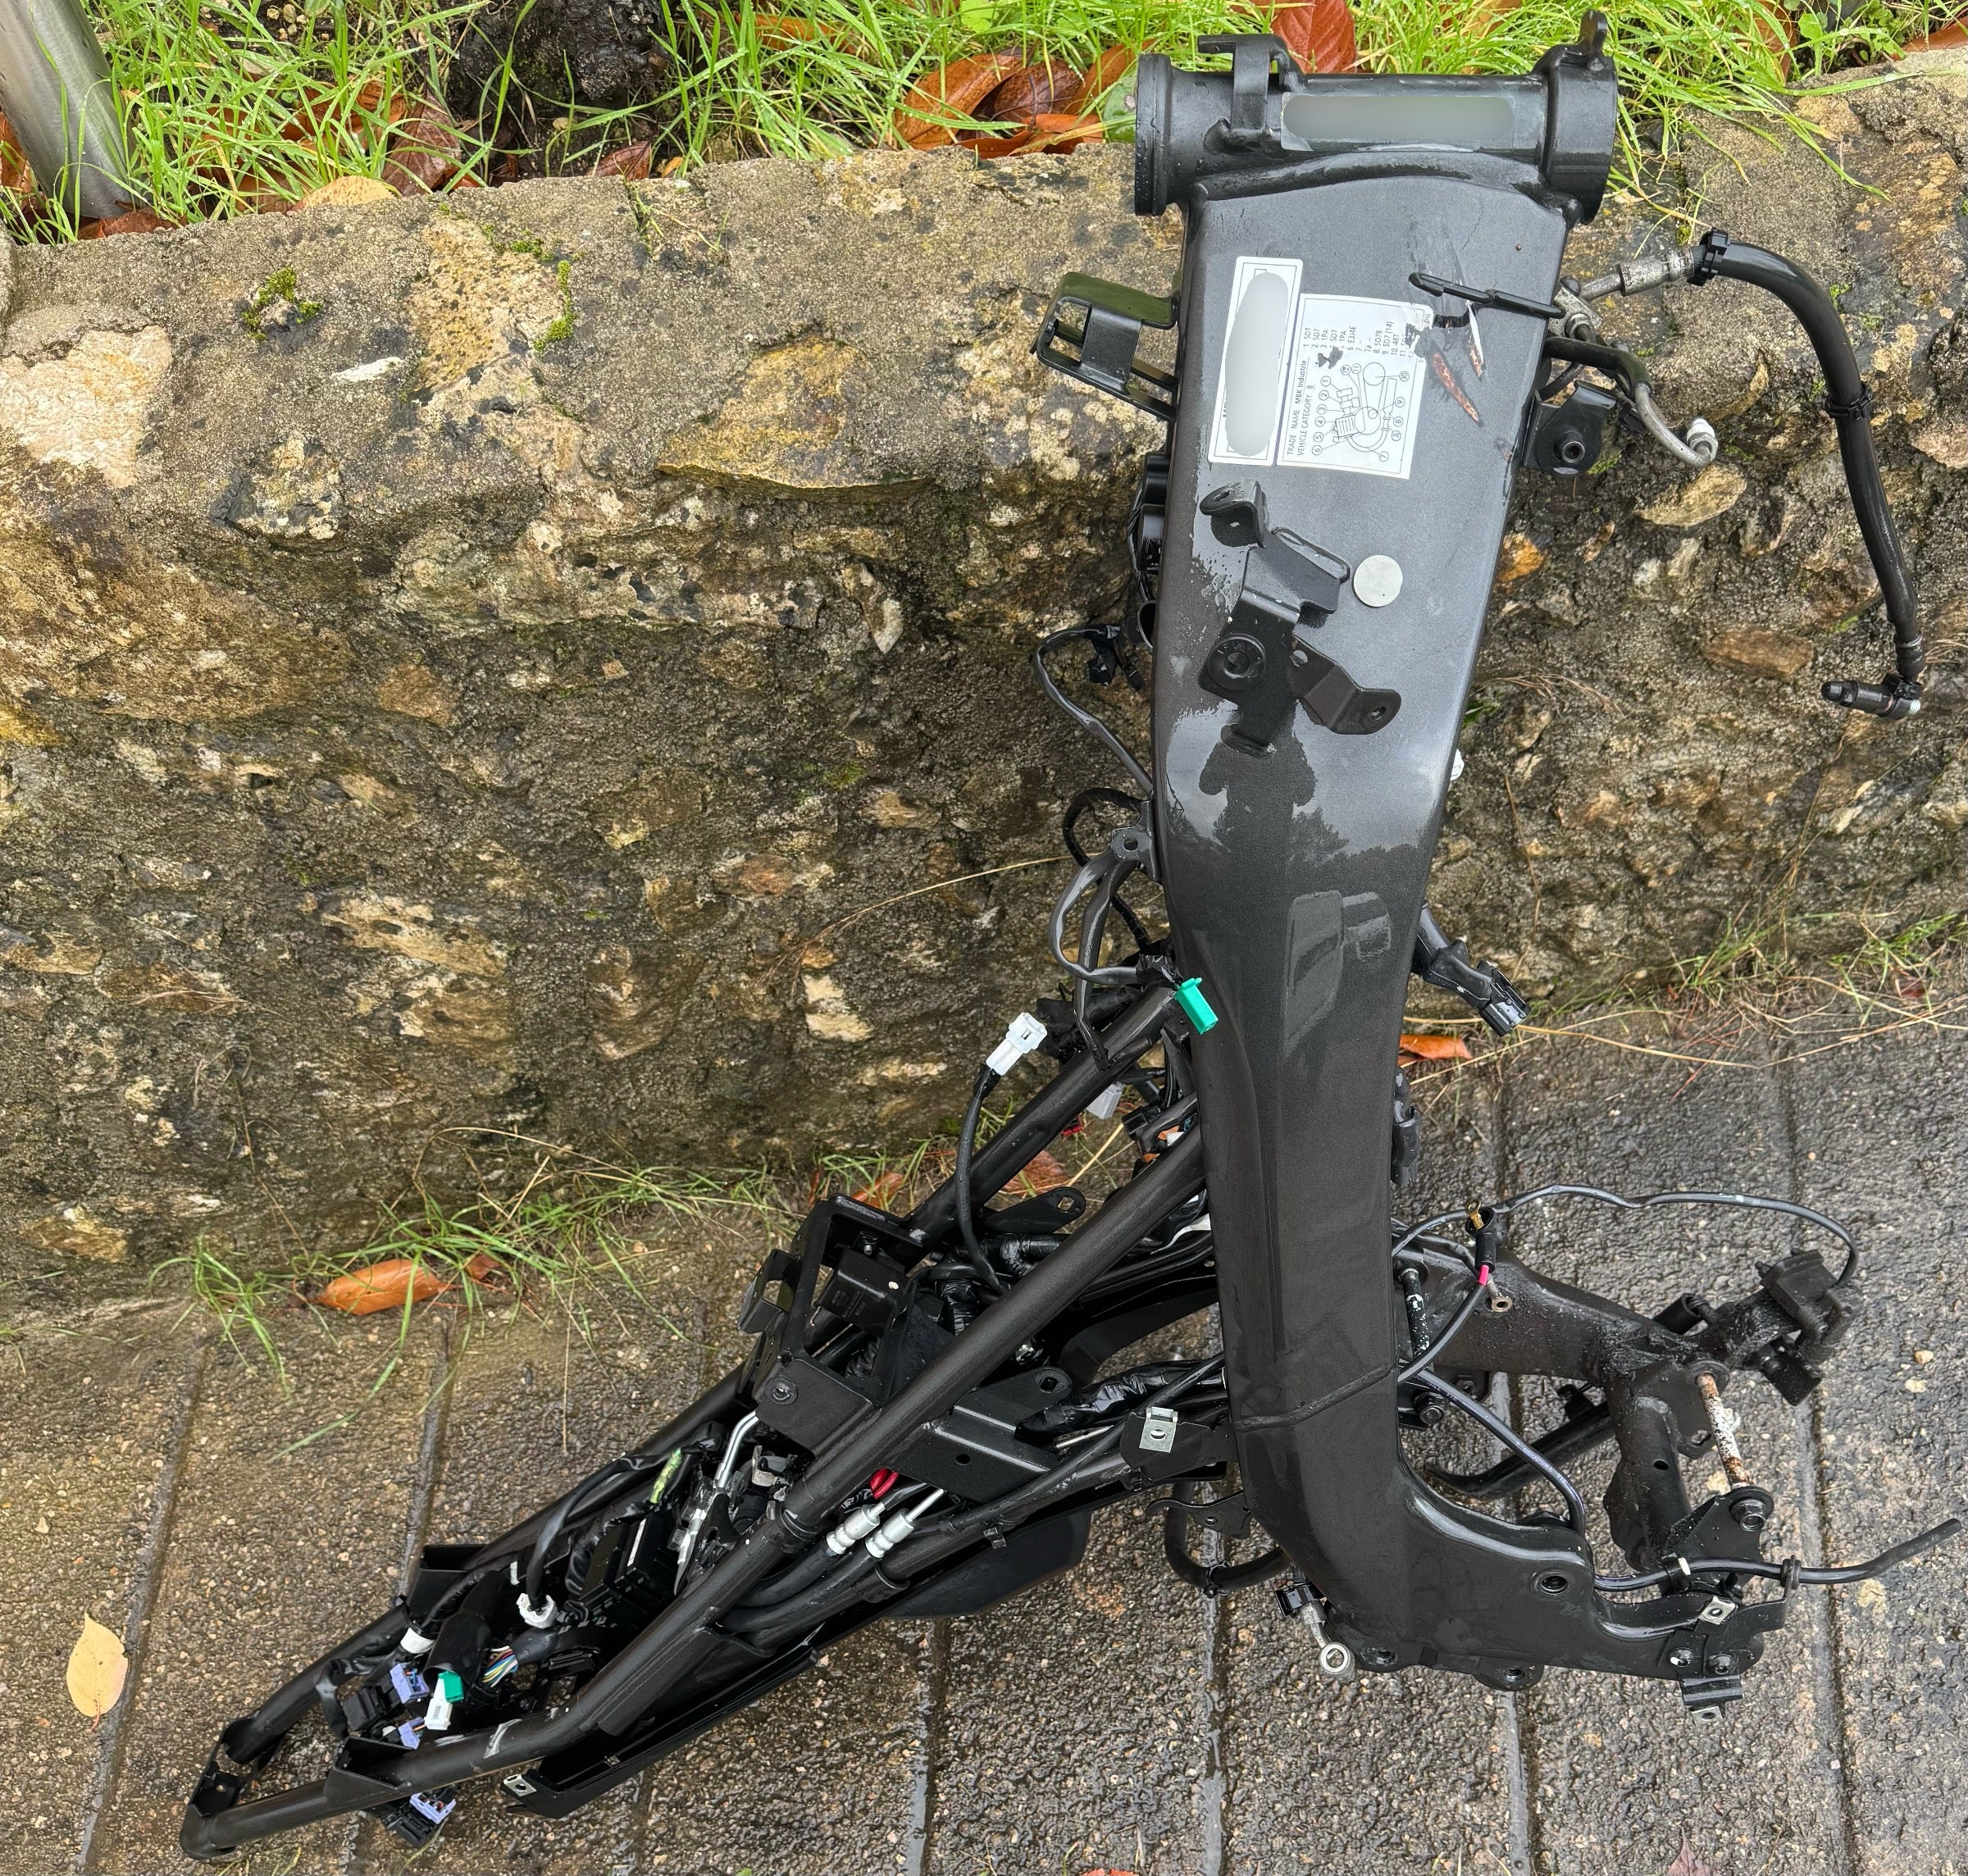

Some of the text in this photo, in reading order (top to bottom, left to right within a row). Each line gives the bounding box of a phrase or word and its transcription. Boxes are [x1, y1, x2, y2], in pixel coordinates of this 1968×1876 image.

[1287, 435, 1296, 455] TRADE
[1292, 410, 1300, 428] NAME
[1297, 360, 1306, 387] Industrie
[1301, 394, 1312, 428] CATEGORY
[1298, 430, 1307, 455] VEHICLE
